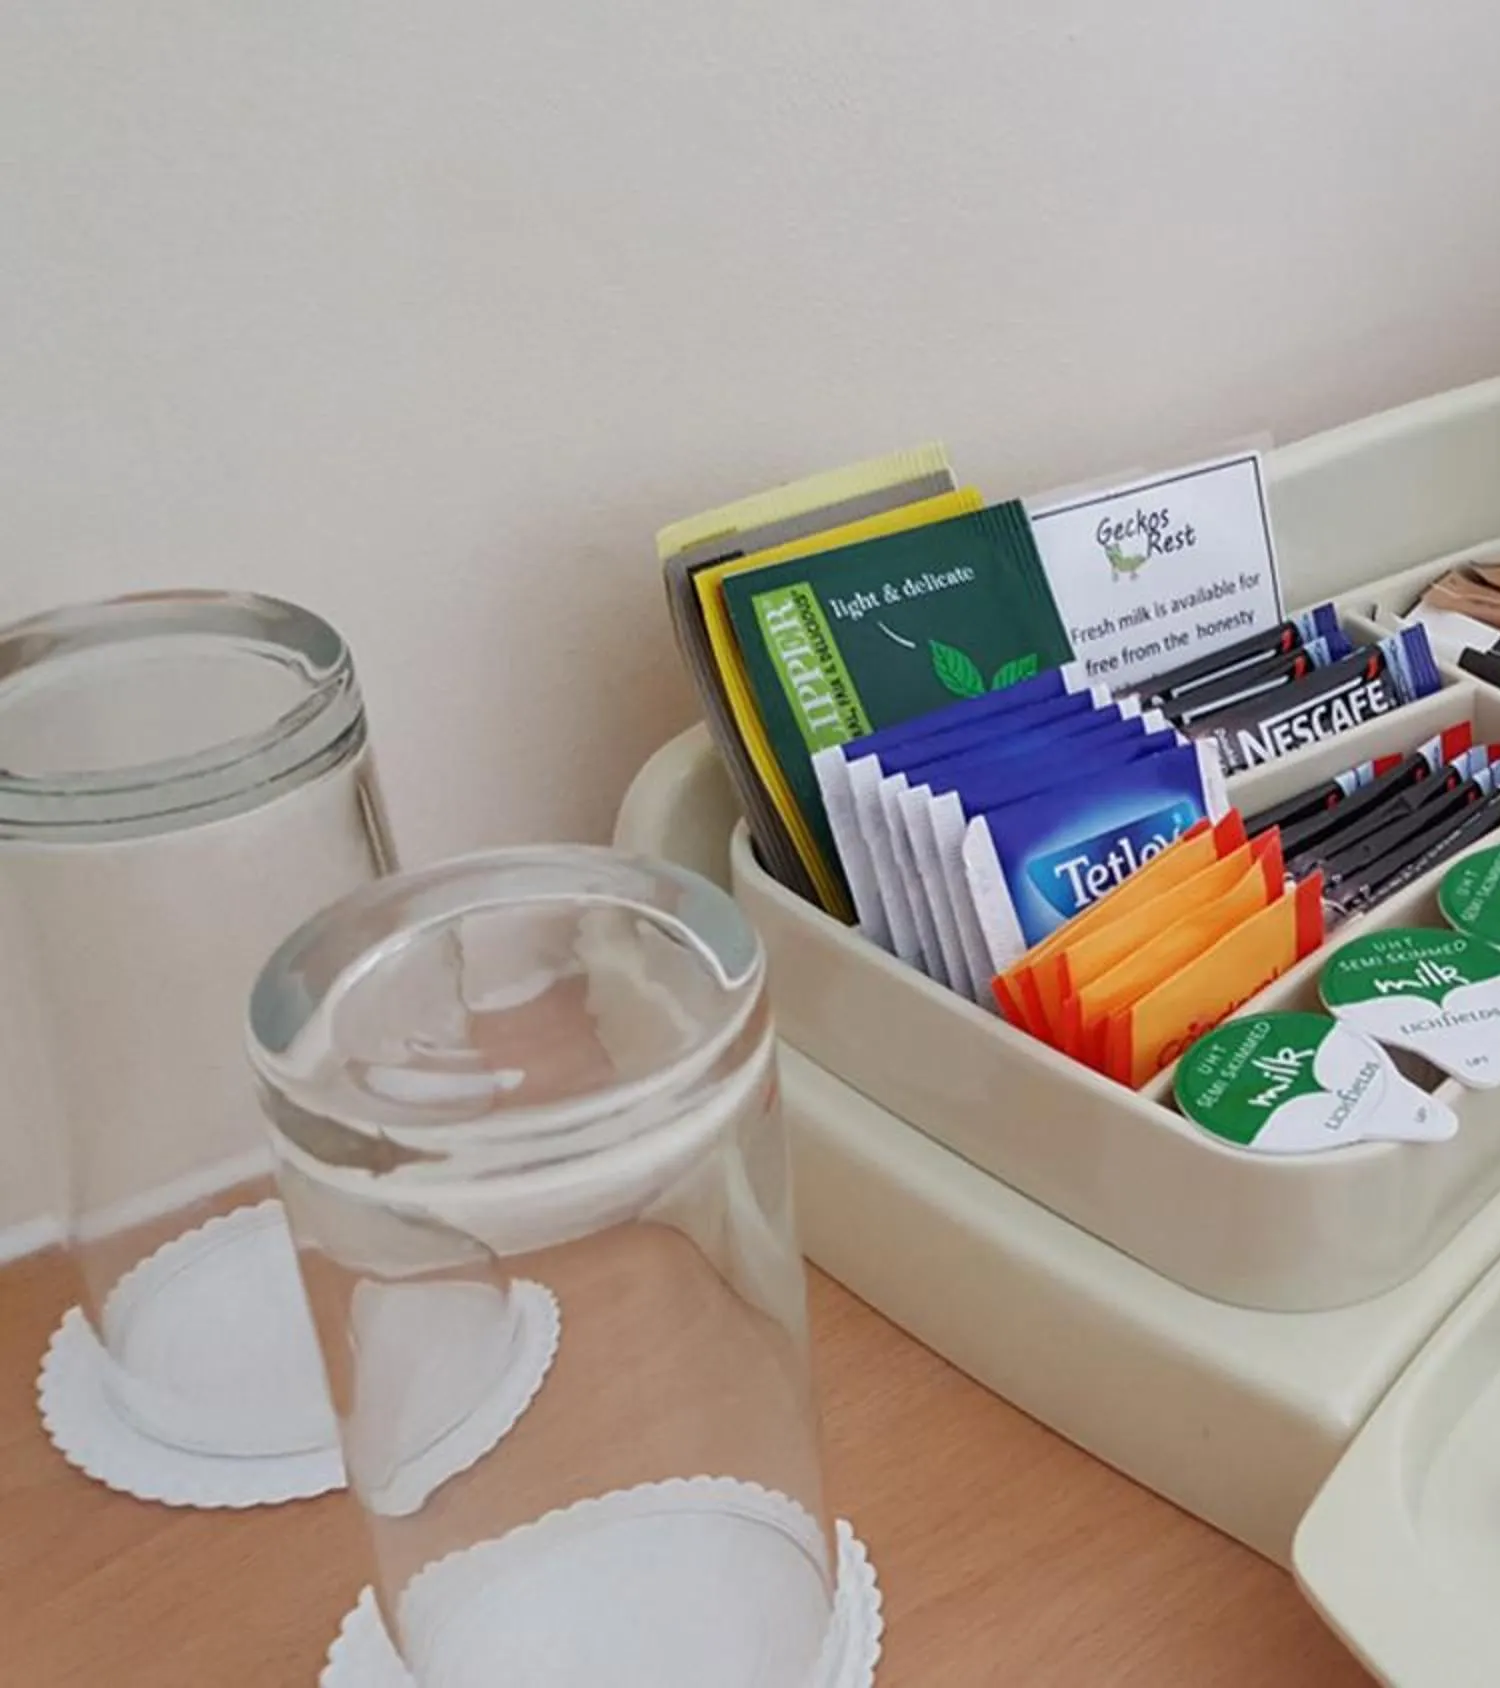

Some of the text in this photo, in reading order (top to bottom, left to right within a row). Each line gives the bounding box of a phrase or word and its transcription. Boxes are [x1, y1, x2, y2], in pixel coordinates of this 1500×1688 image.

[1096, 508, 1169, 545] Geckos
[1147, 524, 1198, 558] Rest
[828, 565, 976, 621] light & delicate
[1071, 572, 1261, 644] Fresh milk is available for
[1085, 609, 1255, 678] free from the honesty
[1338, 939, 1467, 973] SEMI SKIMMED
[1374, 936, 1413, 952] UHT
[1374, 960, 1470, 994] milk
[1196, 1020, 1272, 1110] SEMI SKIMMED
[1198, 1043, 1227, 1075] UHT
[1248, 1047, 1316, 1107] milk
